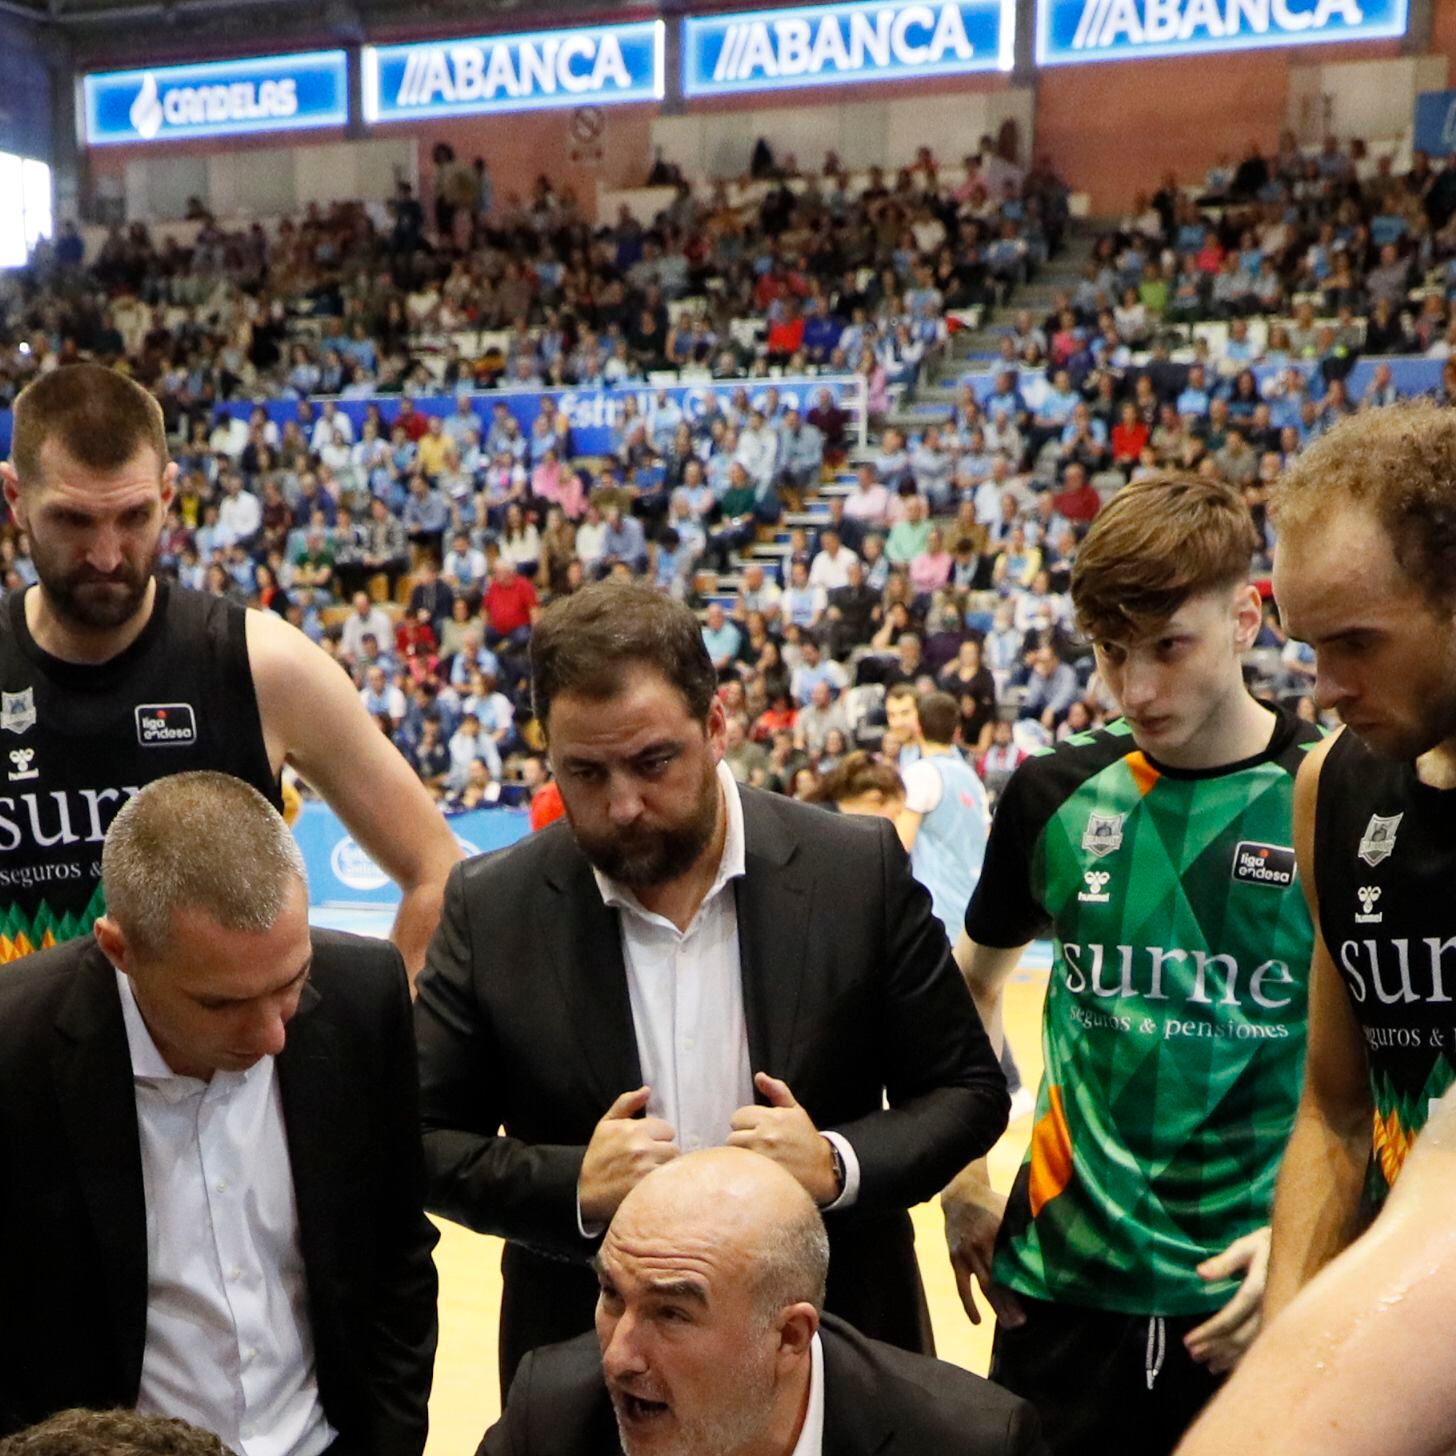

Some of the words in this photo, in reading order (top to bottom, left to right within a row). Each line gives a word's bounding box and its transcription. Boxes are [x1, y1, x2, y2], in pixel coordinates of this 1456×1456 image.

[740, 6, 974, 77] ABANCA
[412, 34, 632, 105] ABANCA
[163, 79, 299, 126] CANDELAS
[142, 717, 166, 731] liga
[143, 727, 192, 741] endesa
[1239, 852, 1265, 868] liga
[0, 861, 82, 888] seguros
[1238, 866, 1291, 883] endesa
[1063, 942, 1293, 1009] surne
[1070, 1004, 1131, 1030] seguros
[1139, 1017, 1157, 1034] &
[1163, 1019, 1290, 1040] pensiones
[1363, 1026, 1421, 1050] guros
[1429, 1026, 1444, 1047] &
